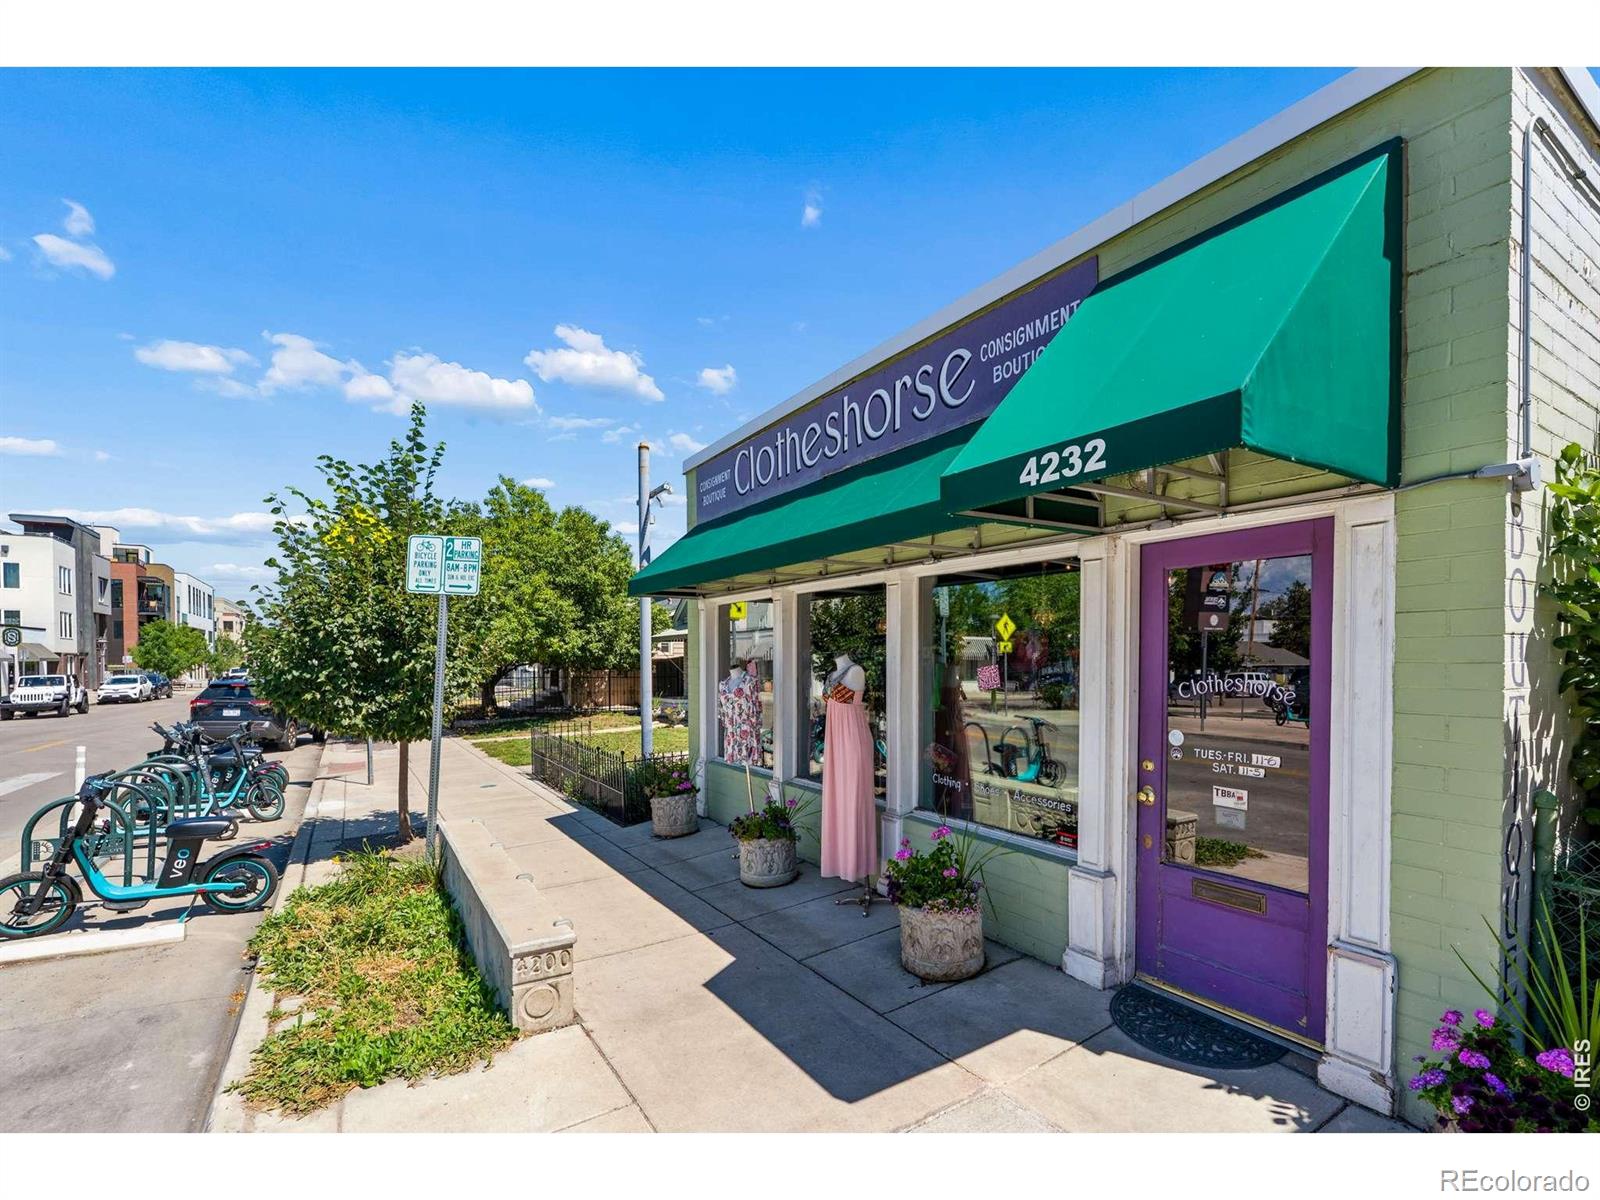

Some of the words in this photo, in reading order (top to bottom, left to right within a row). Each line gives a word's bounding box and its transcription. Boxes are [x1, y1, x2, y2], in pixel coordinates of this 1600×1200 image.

[980, 299, 1081, 362] CONSIGNMENT
[734, 347, 976, 495] Clotheshorse
[1019, 438, 1107, 487] 4232
[699, 469, 731, 492] CONSIGNMENT
[702, 487, 727, 506] BOUTIQUE
[446, 542, 454, 557] 2
[454, 550, 479, 559] PARKING
[461, 541, 472, 549] HR
[414, 552, 437, 560] BICYCLE
[414, 561, 437, 569] PARKING
[1178, 675, 1296, 705] Clotheshorse
[1212, 762, 1236, 775] SAT.
[932, 773, 962, 792] Clothing
[1013, 788, 1073, 812] Accessories
[1214, 787, 1236, 798] TBBA
[169, 848, 191, 879] veo
[516, 949, 571, 976] 4200
